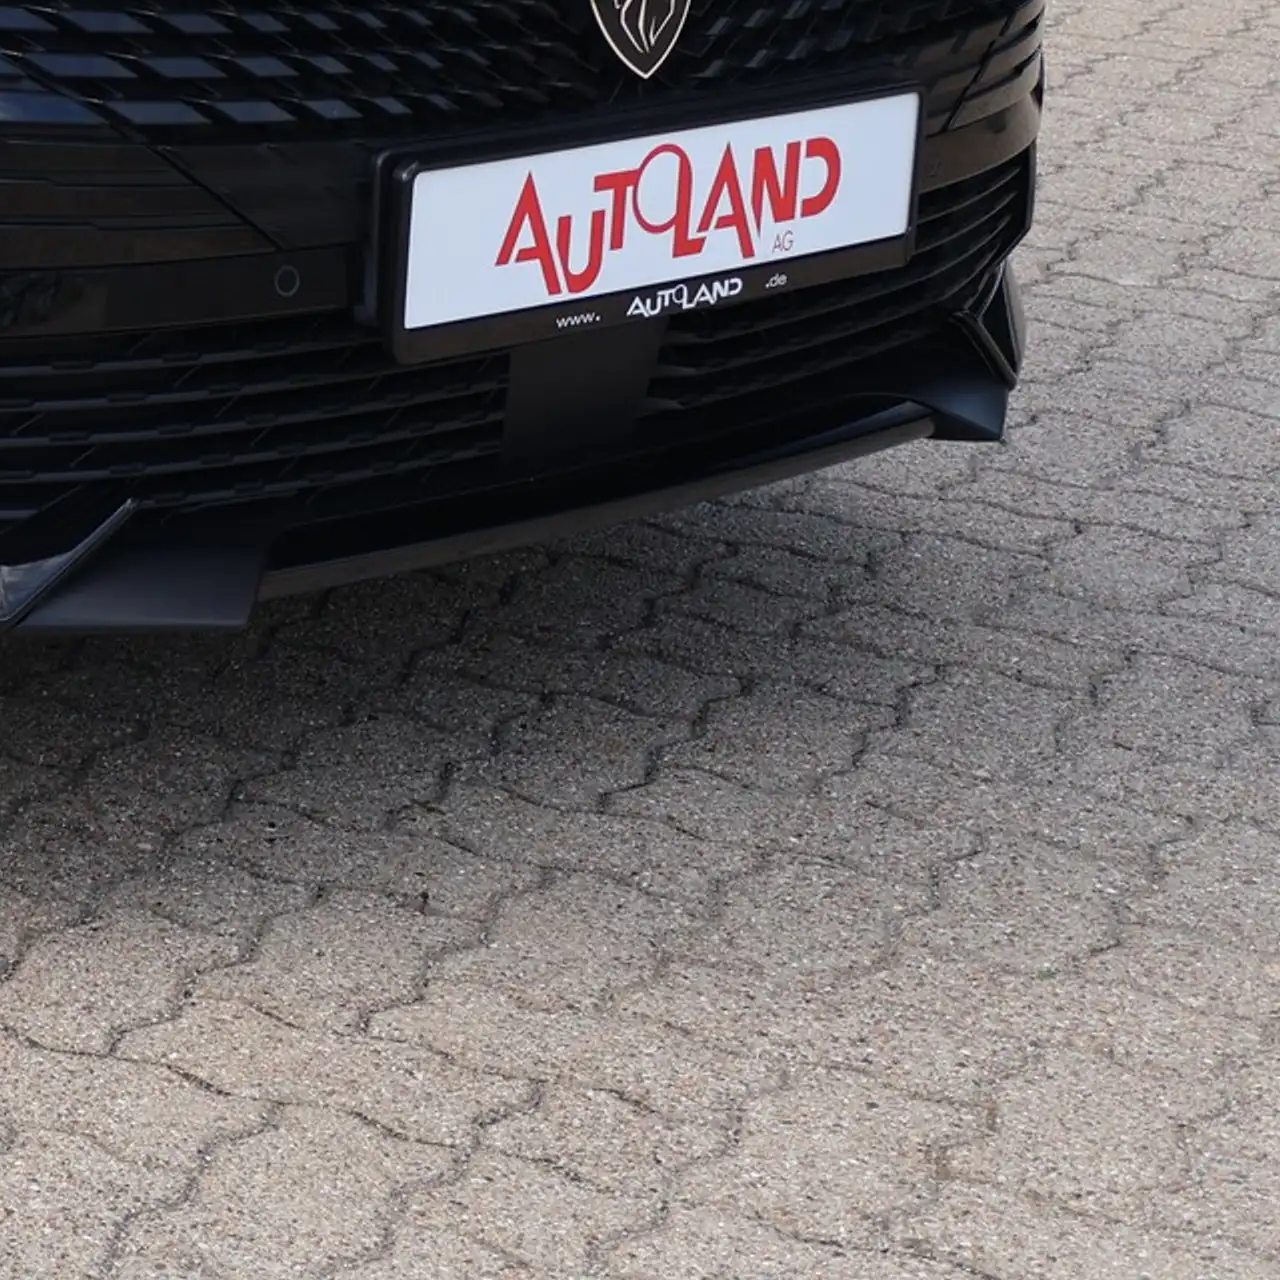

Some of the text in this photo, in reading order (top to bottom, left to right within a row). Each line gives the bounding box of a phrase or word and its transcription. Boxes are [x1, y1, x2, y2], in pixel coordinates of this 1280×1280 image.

[771, 229, 795, 254] AG
[555, 311, 601, 328] www.
[764, 270, 788, 289] .de
